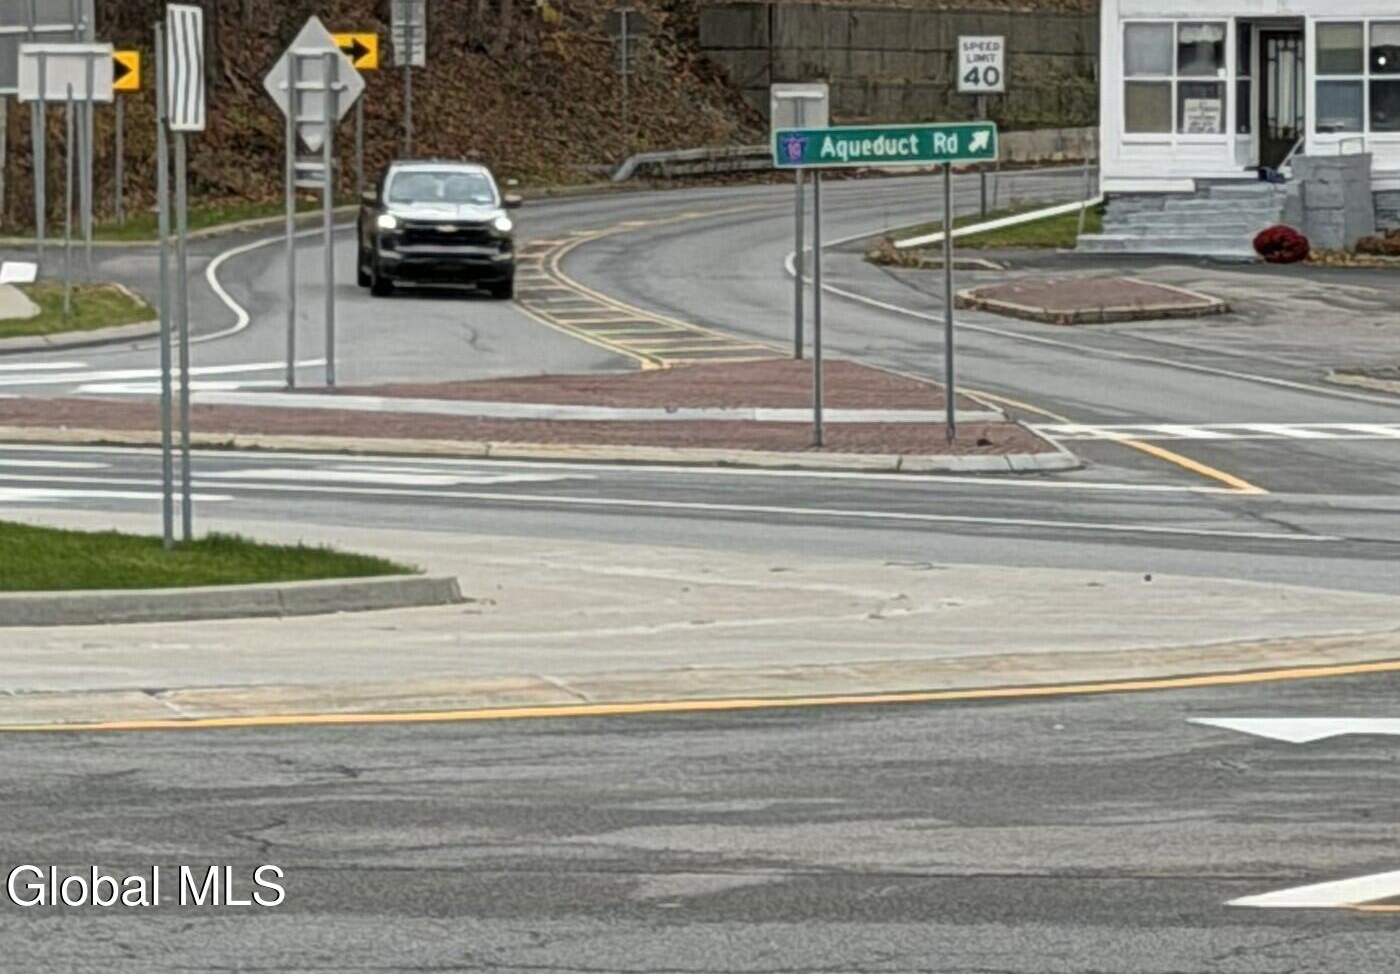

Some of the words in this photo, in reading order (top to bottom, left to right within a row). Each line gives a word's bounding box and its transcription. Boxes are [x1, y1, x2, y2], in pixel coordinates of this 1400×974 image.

[962, 65, 1001, 87] 40
[819, 133, 919, 163] Aqueduct
[932, 130, 959, 156] Rd
